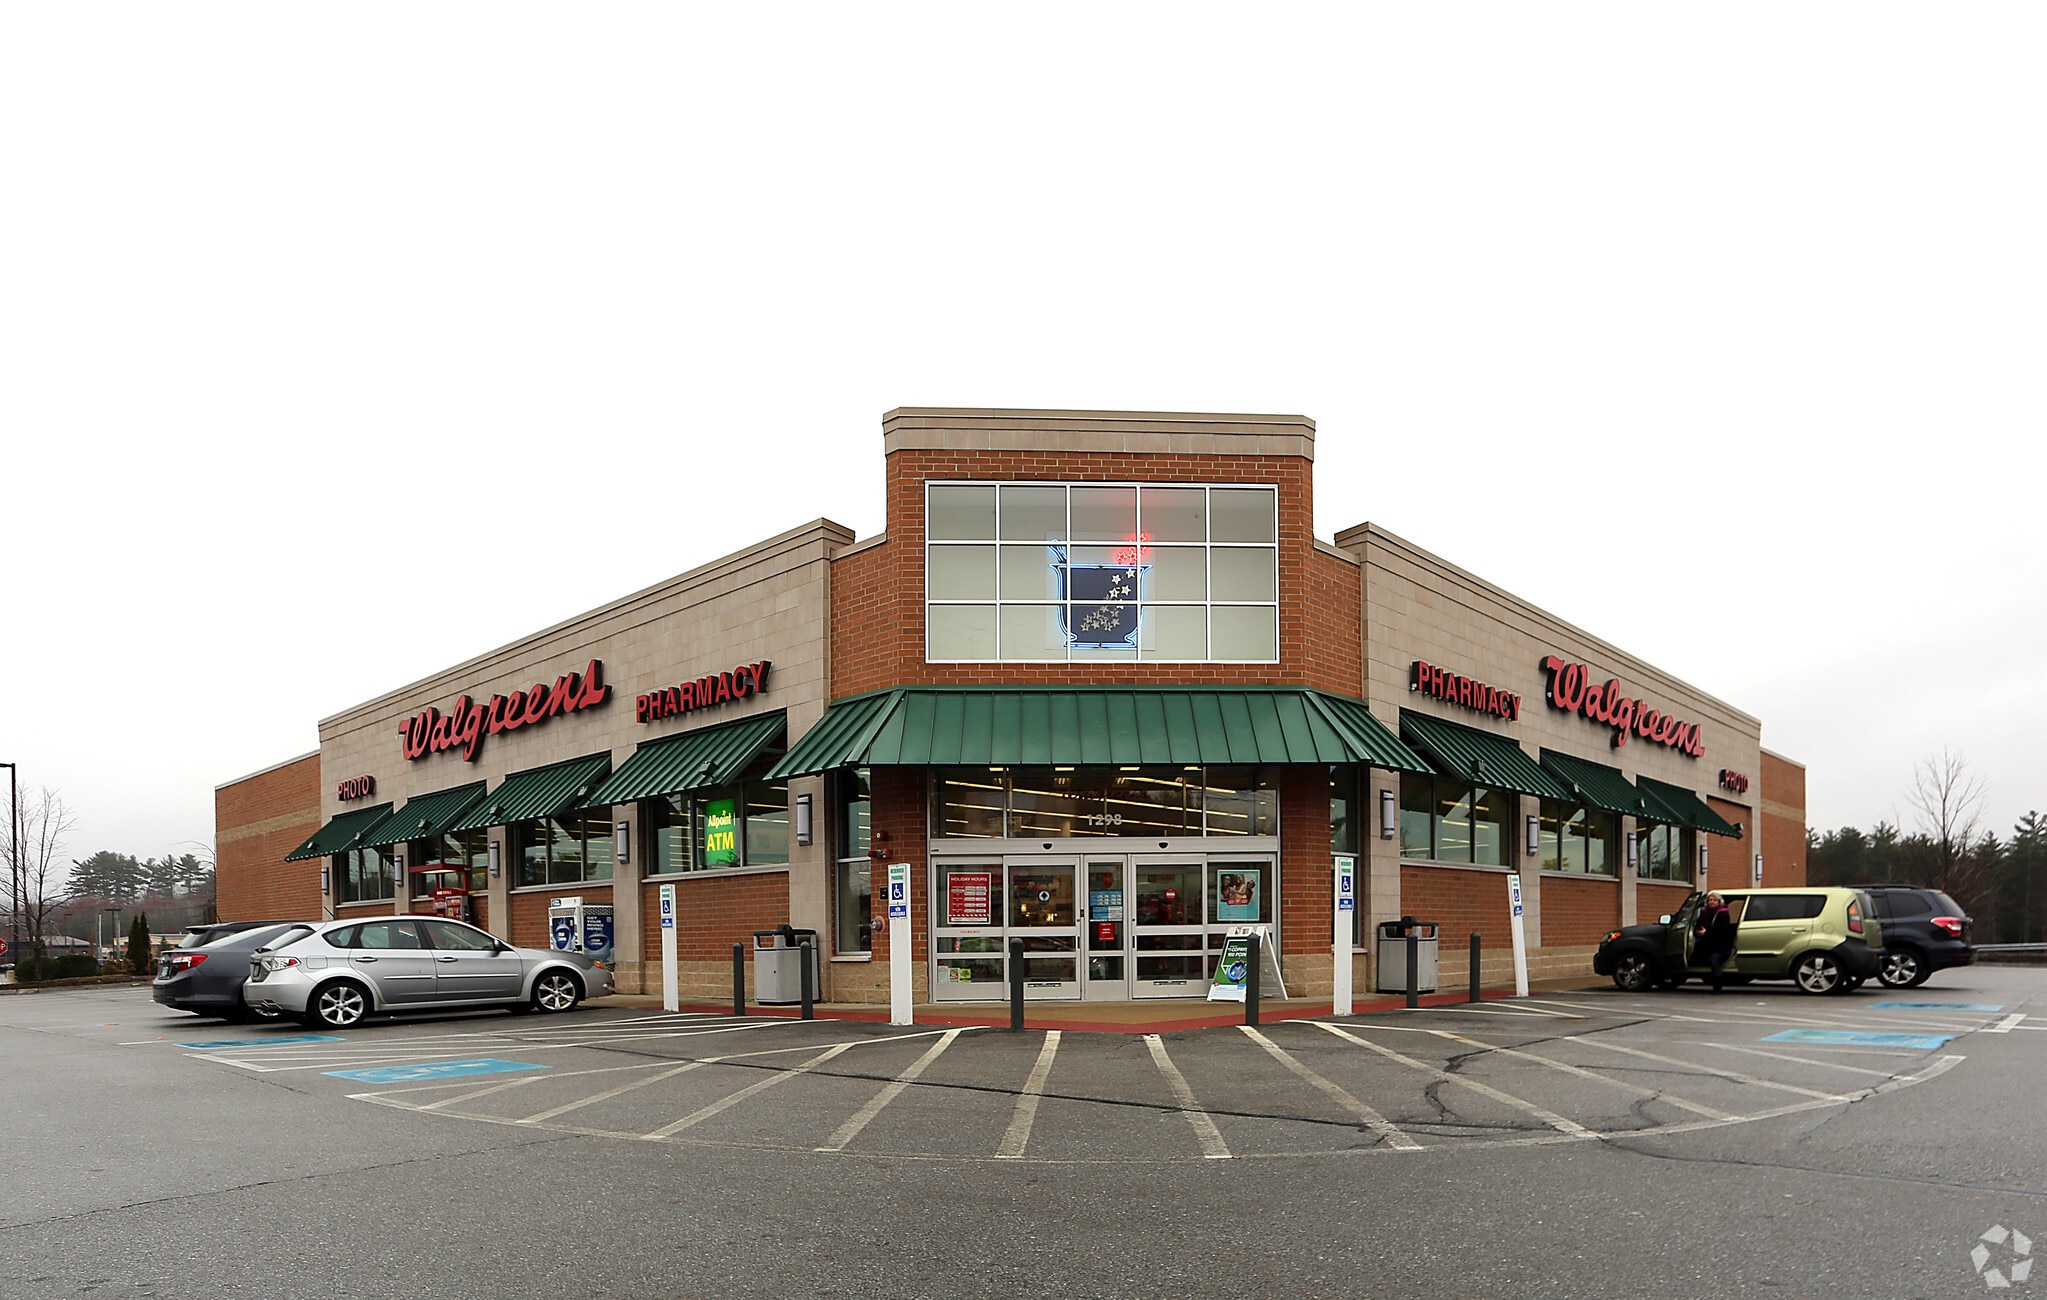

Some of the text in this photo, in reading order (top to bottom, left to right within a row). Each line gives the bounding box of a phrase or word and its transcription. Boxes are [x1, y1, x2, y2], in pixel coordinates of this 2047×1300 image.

[398, 658, 609, 762] Walgreens
[636, 660, 771, 723] PHARMACY
[1414, 660, 1522, 721] PHARMACY
[1543, 654, 1706, 758] Walgreens
[337, 774, 372, 801] PHOTO
[1723, 768, 1750, 792] PHOTO
[706, 832, 735, 852] ATM
[1086, 813, 1122, 827] 1298
